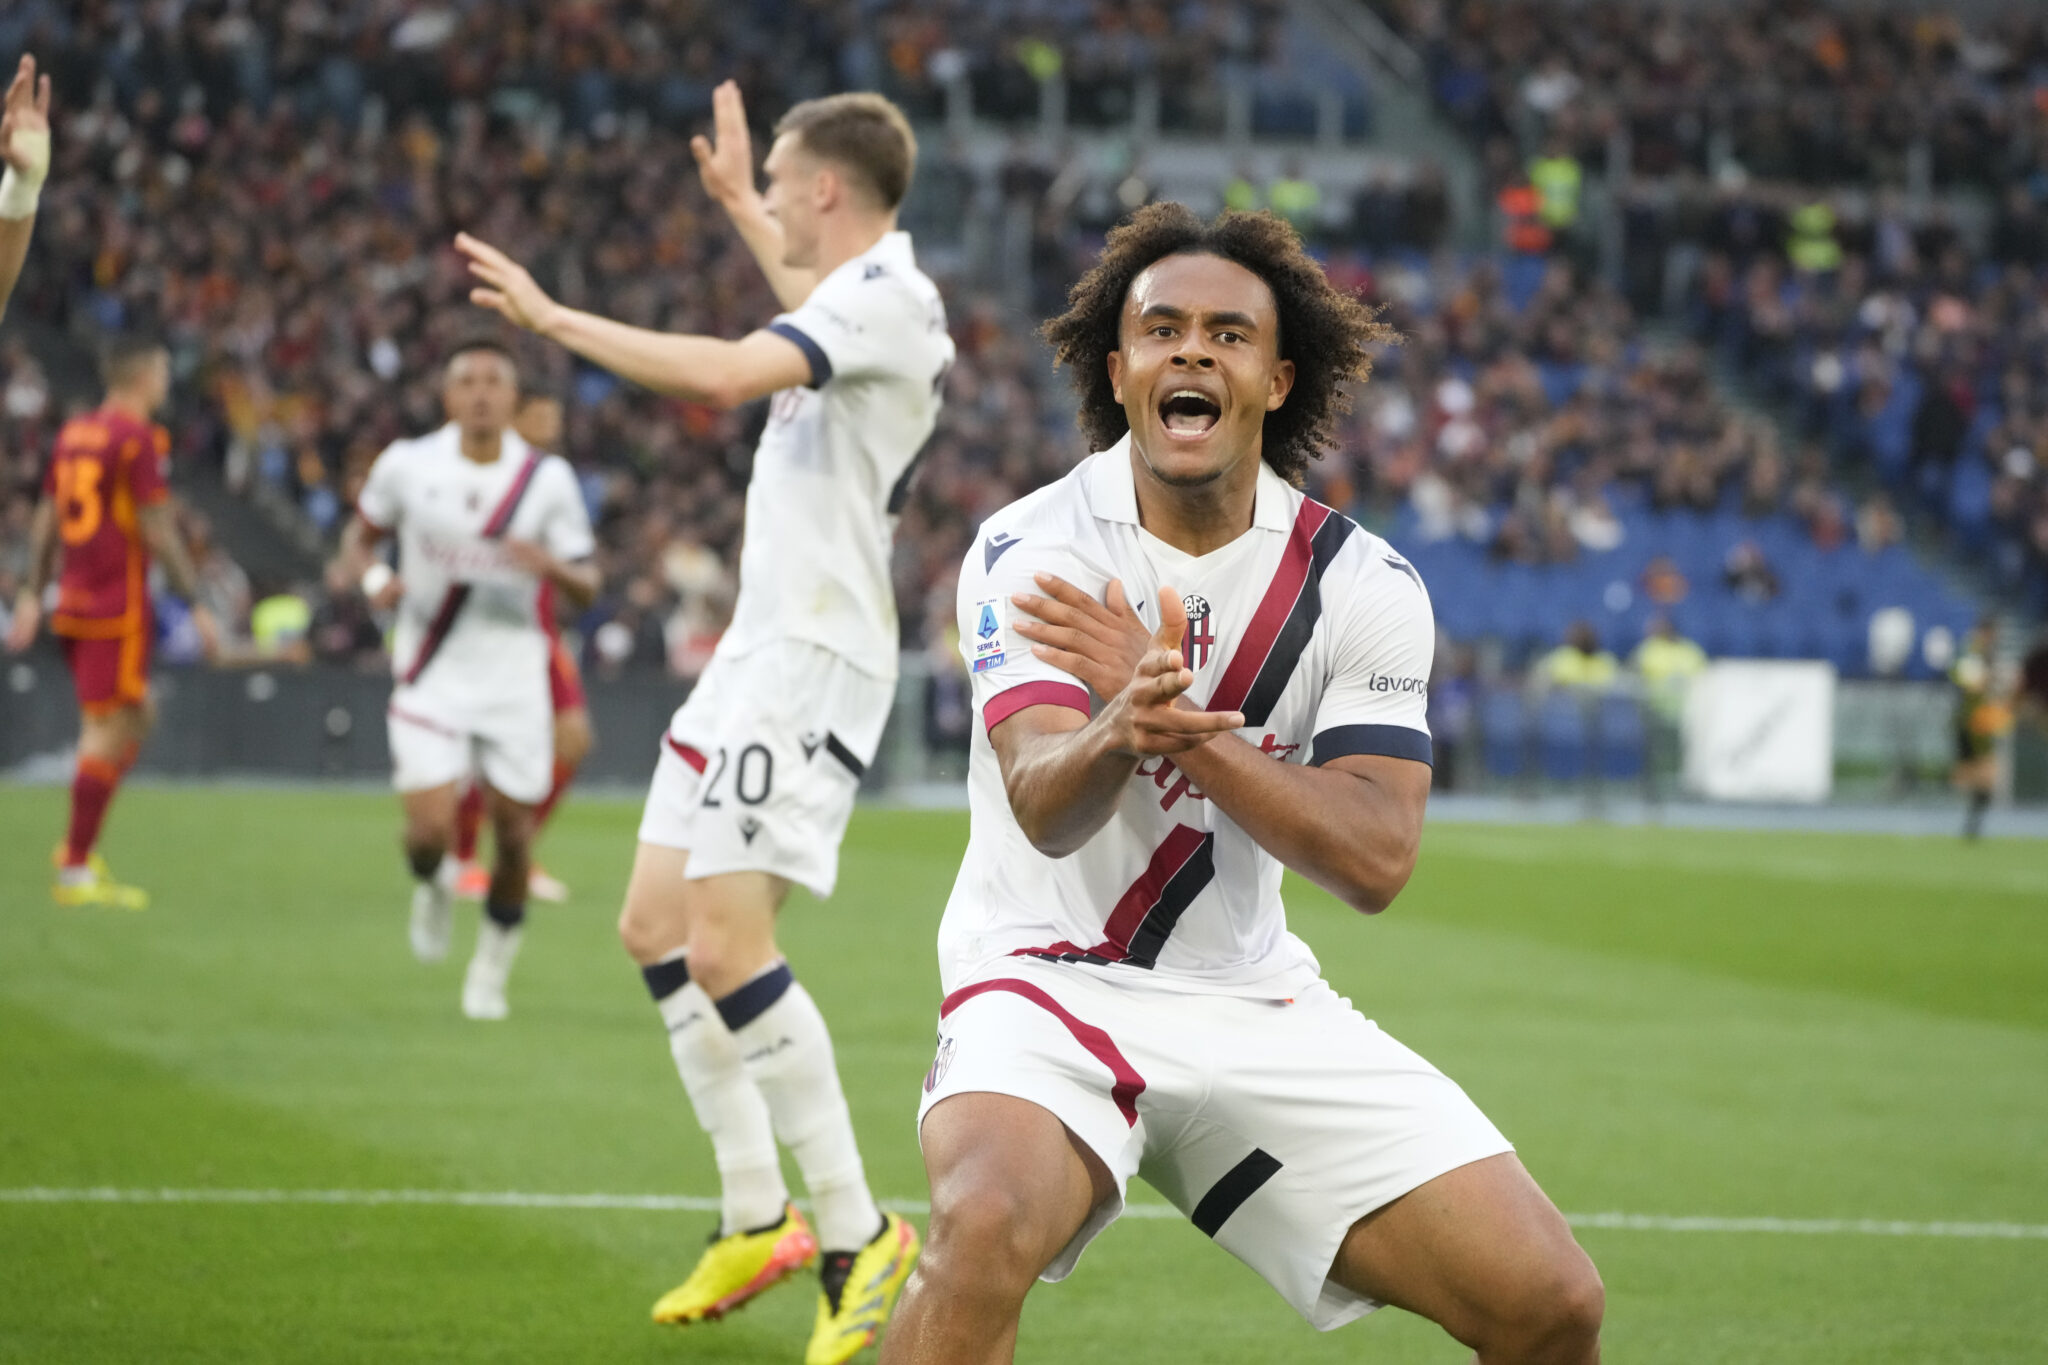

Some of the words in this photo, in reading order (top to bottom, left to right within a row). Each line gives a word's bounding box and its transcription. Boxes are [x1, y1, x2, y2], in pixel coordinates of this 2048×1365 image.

[1184, 595, 1206, 612] BFC
[977, 642, 993, 652] SERIE
[987, 656, 1002, 668] TIM
[1368, 673, 1428, 701] lavoro
[702, 743, 773, 807] 20
